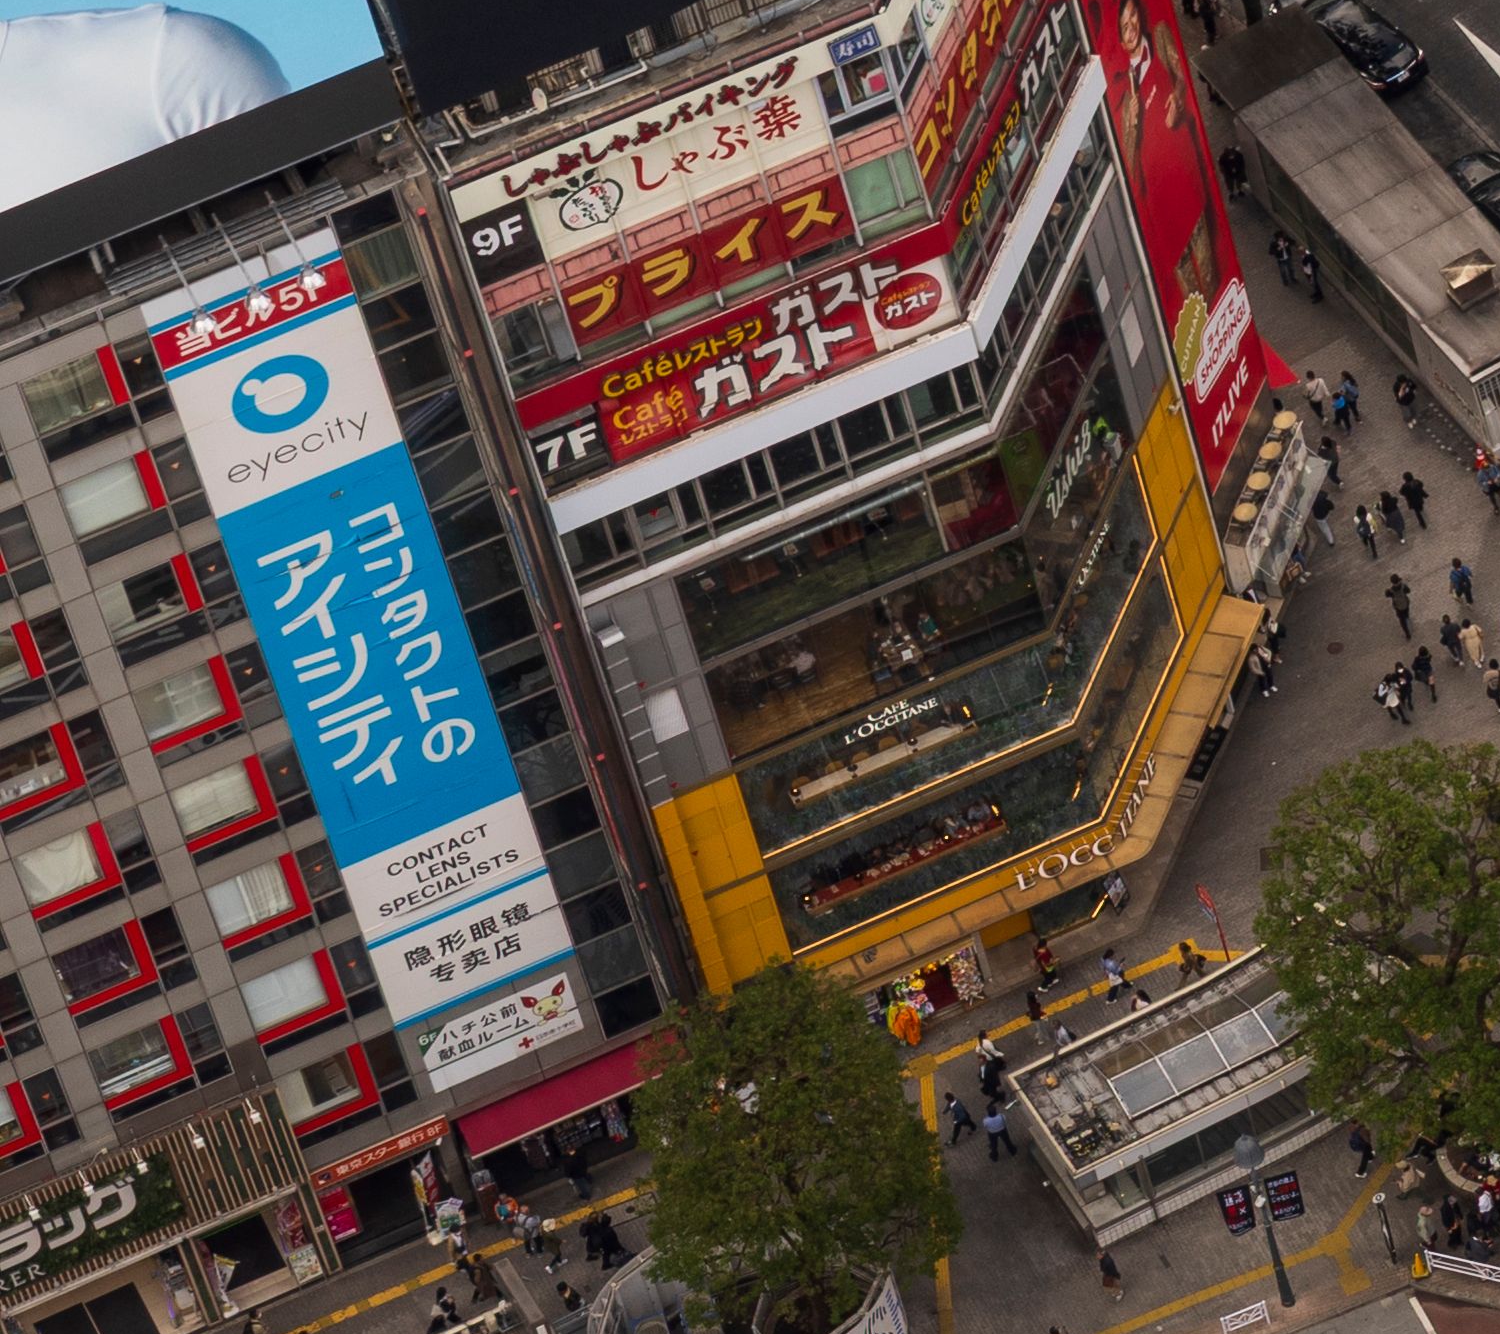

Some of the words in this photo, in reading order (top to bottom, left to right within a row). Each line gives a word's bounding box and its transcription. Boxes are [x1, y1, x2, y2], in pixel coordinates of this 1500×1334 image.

[836, 28, 878, 61] 寿司
[1020, 2, 1067, 114] ガスト
[501, 55, 801, 199] しゃぶしゃぶバイキング
[631, 94, 803, 193] しゃぶ葉
[961, 100, 1021, 228] Caféレストラン
[472, 214, 526, 258] 9F
[568, 187, 842, 329] プライス
[773, 260, 898, 334] ガスト
[884, 289, 937, 321] ガスト
[603, 317, 764, 399] Caféレストラン
[694, 320, 857, 422] ガスト
[1180, 302, 1203, 375] CUTMAN
[1200, 301, 1248, 387] SHOPPING!
[612, 385, 685, 432] Café
[619, 405, 688, 446] レストラン
[1211, 355, 1249, 449] 17LIVE
[227, 410, 369, 484] eyecity
[536, 423, 597, 474] 7F
[257, 527, 399, 788] アイシティ
[348, 502, 478, 766] コンタクトの
[844, 696, 939, 746] L'OCCITANE
[867, 697, 911, 724] CAFE
[379, 848, 520, 918] SPECIALISTS
[387, 823, 490, 878] CONTACT
[416, 850, 472, 885] LENS
[404, 902, 533, 972] 隐形眼镜
[429, 932, 523, 985] 专卖店
[437, 1015, 531, 1063] 献血ルーム
[441, 1001, 520, 1044] ハチ公前
[333, 1128, 426, 1178] 東京スター銀行
[426, 1121, 446, 1138] 8F
